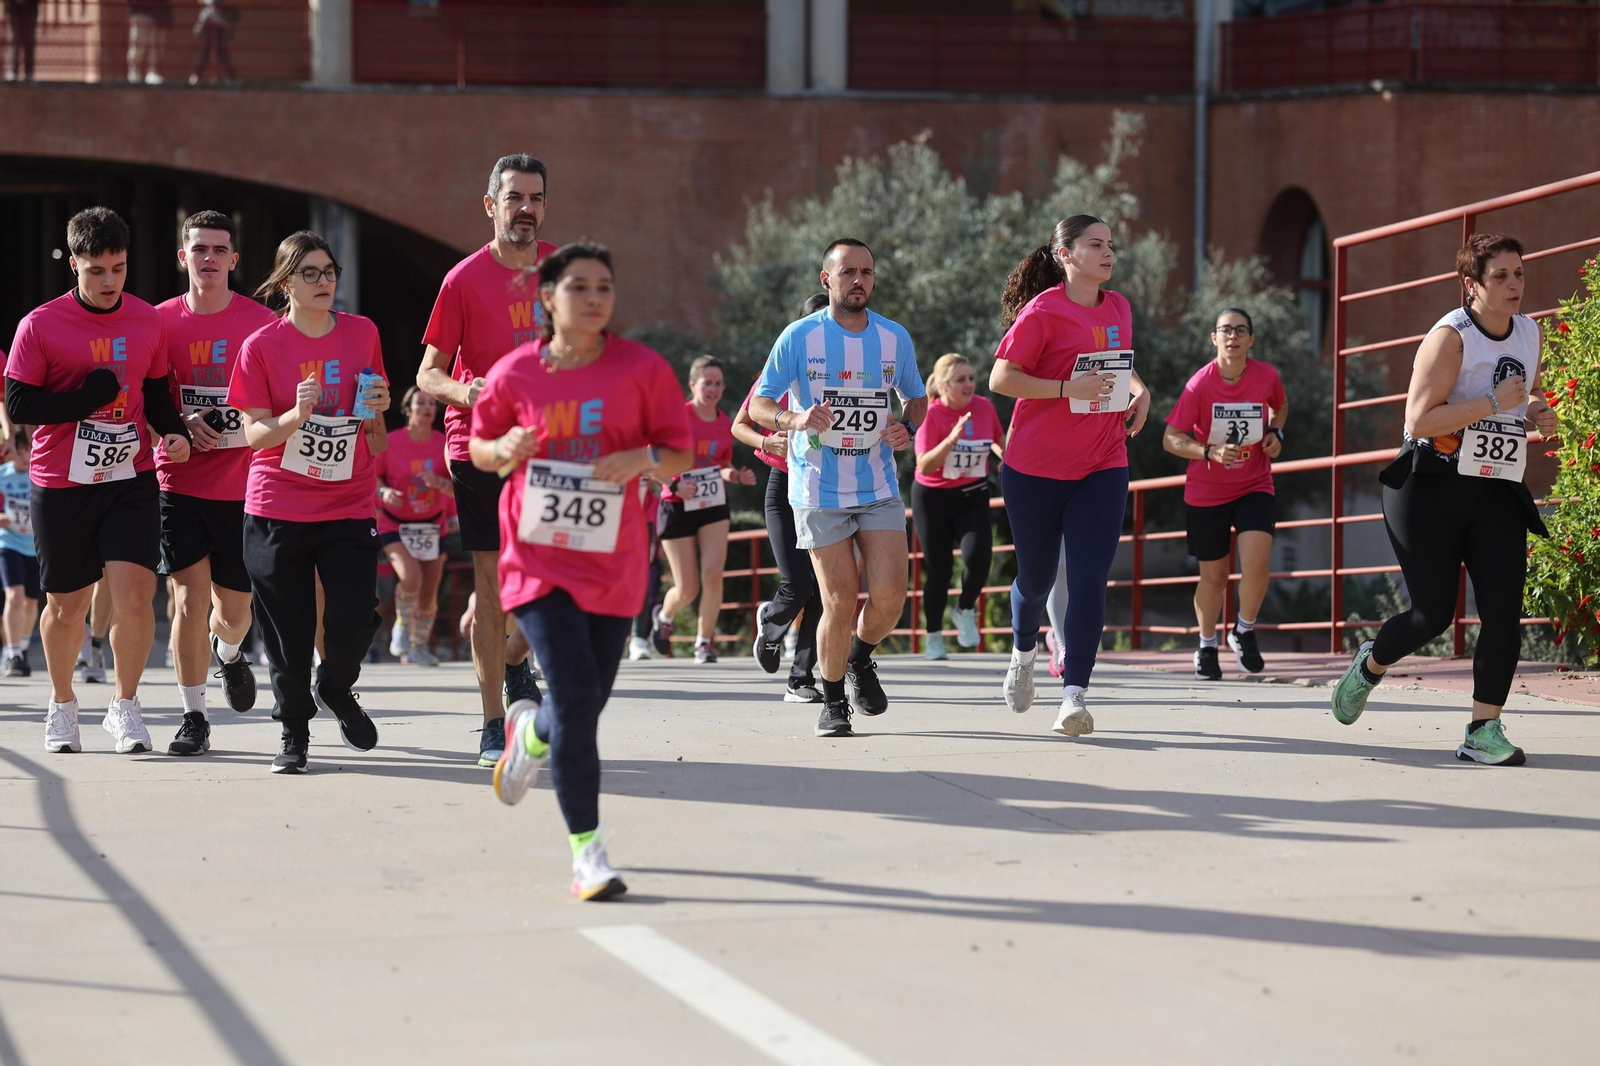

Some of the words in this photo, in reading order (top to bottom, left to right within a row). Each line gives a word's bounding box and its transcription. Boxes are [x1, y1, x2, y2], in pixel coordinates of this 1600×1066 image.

[1092, 325, 1120, 349] WE
[89, 336, 127, 363] WE
[189, 340, 227, 365] WE
[300, 360, 340, 384] WE
[184, 395, 213, 406] UMA
[824, 396, 854, 406] UMA
[545, 398, 605, 438] WE
[831, 409, 878, 432] 249
[1470, 421, 1499, 432] UMA
[80, 429, 112, 443] UMA
[842, 438, 854, 447] WE
[85, 443, 132, 467] 586
[299, 434, 348, 463] 398
[697, 440, 719, 456] WE
[1473, 434, 1519, 462] 382
[93, 472, 105, 482] WE
[308, 466, 322, 478] WE
[531, 472, 576, 491] UMA
[693, 481, 719, 497] 20
[540, 493, 607, 527] 348
